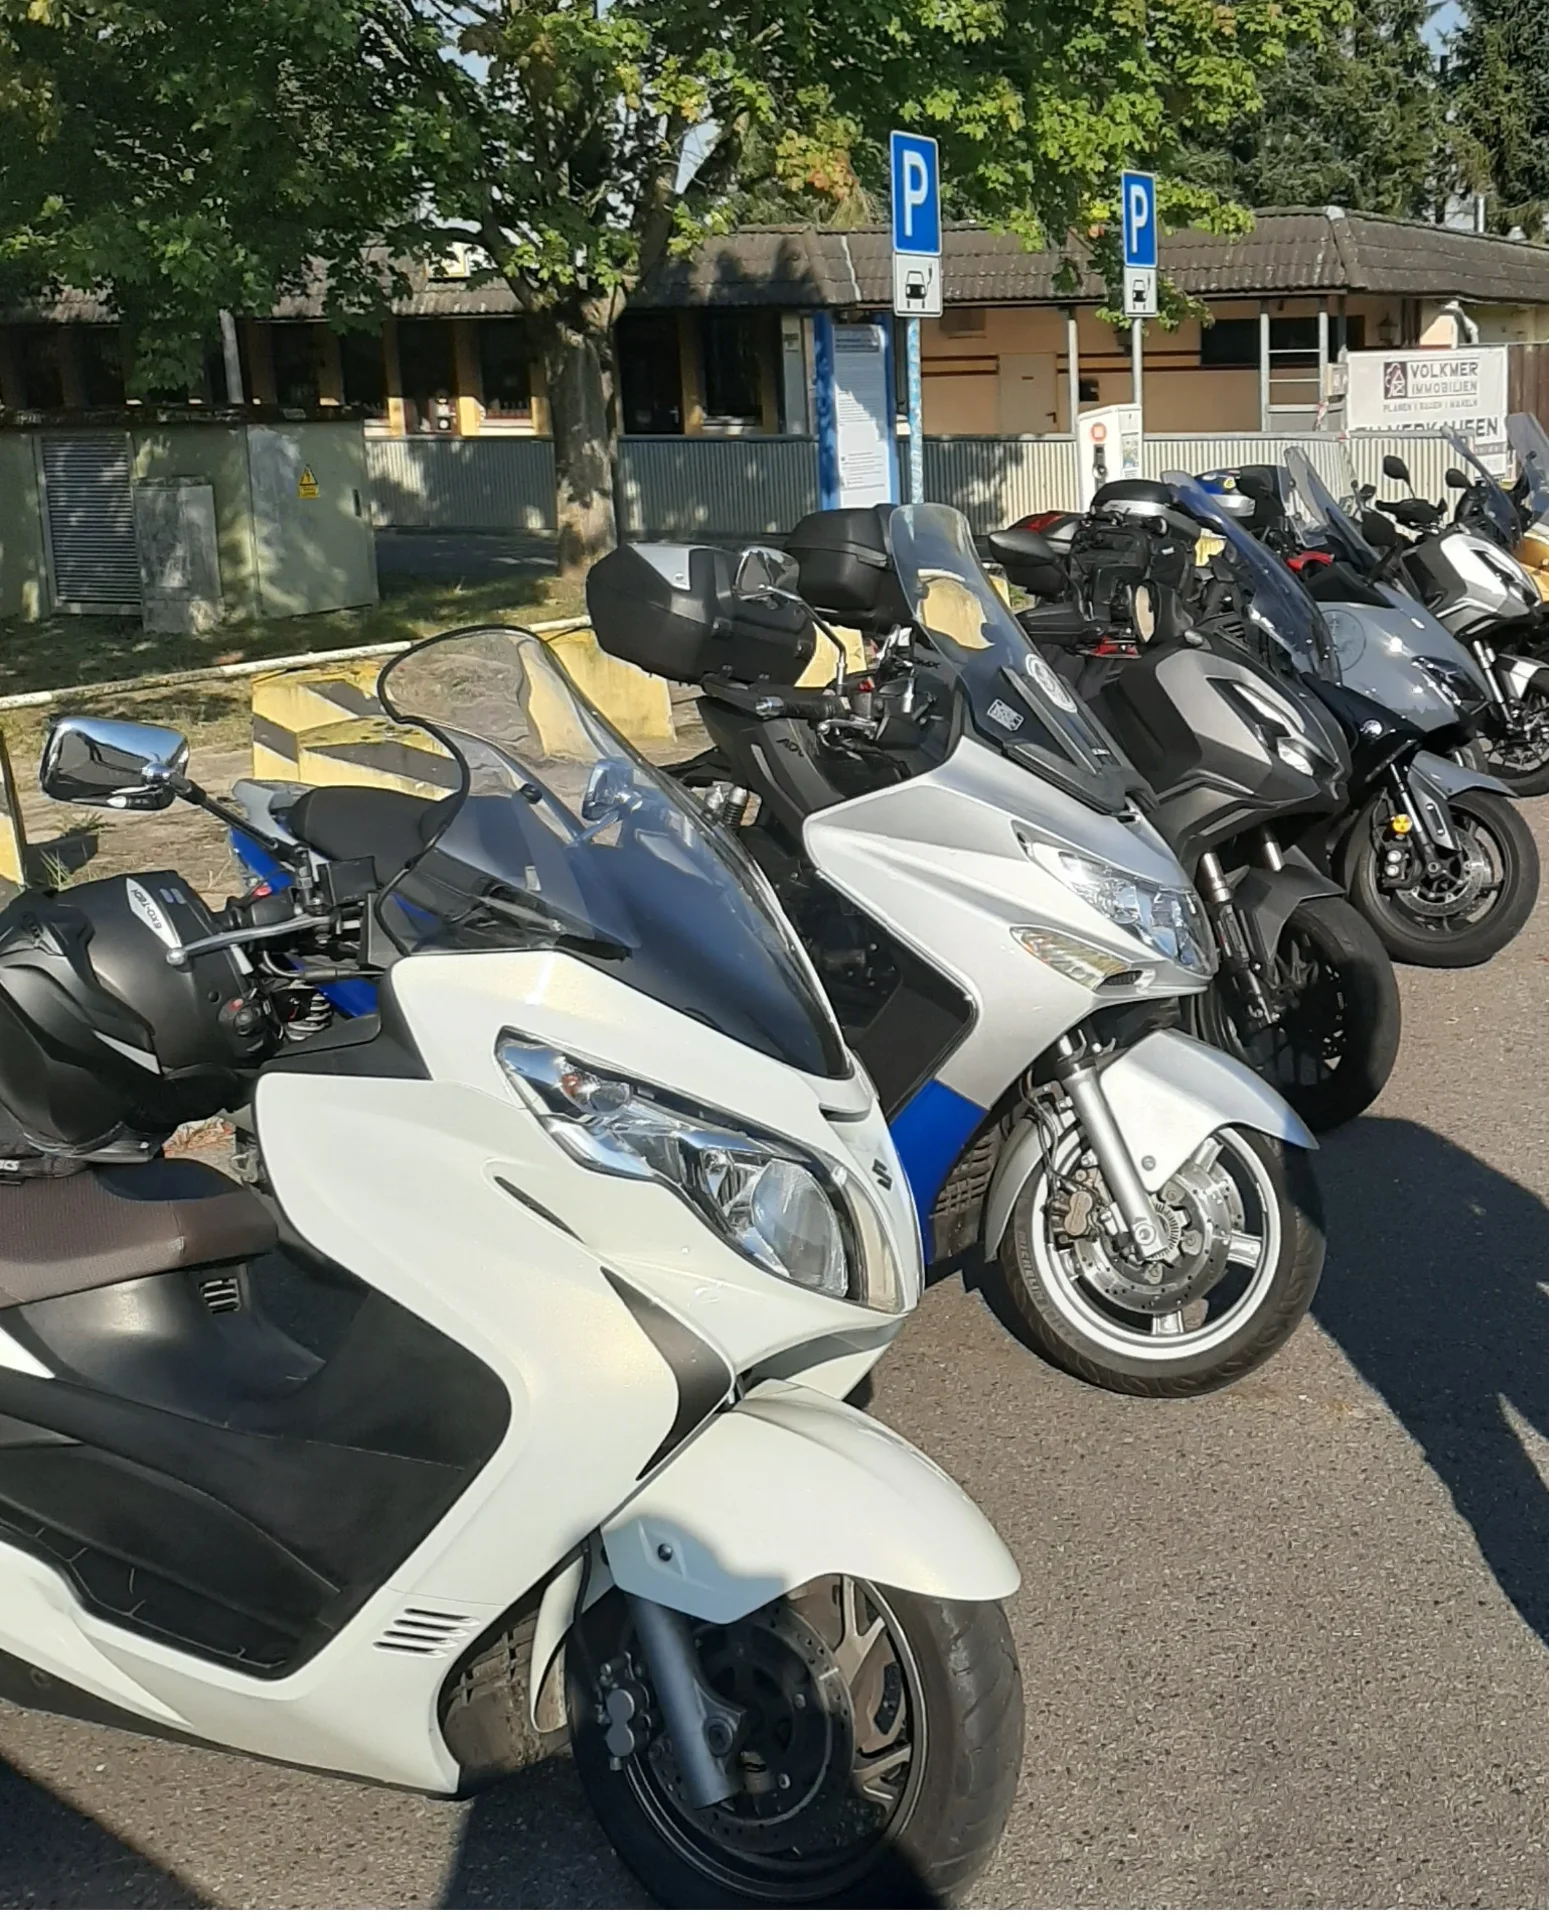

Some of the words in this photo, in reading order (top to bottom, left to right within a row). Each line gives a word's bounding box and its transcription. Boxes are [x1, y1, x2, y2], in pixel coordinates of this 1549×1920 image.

[903, 150, 928, 237] P
[1130, 184, 1149, 253] P
[1410, 362, 1479, 378] VOLKMER
[1411, 380, 1478, 395] IMMOBILIEN
